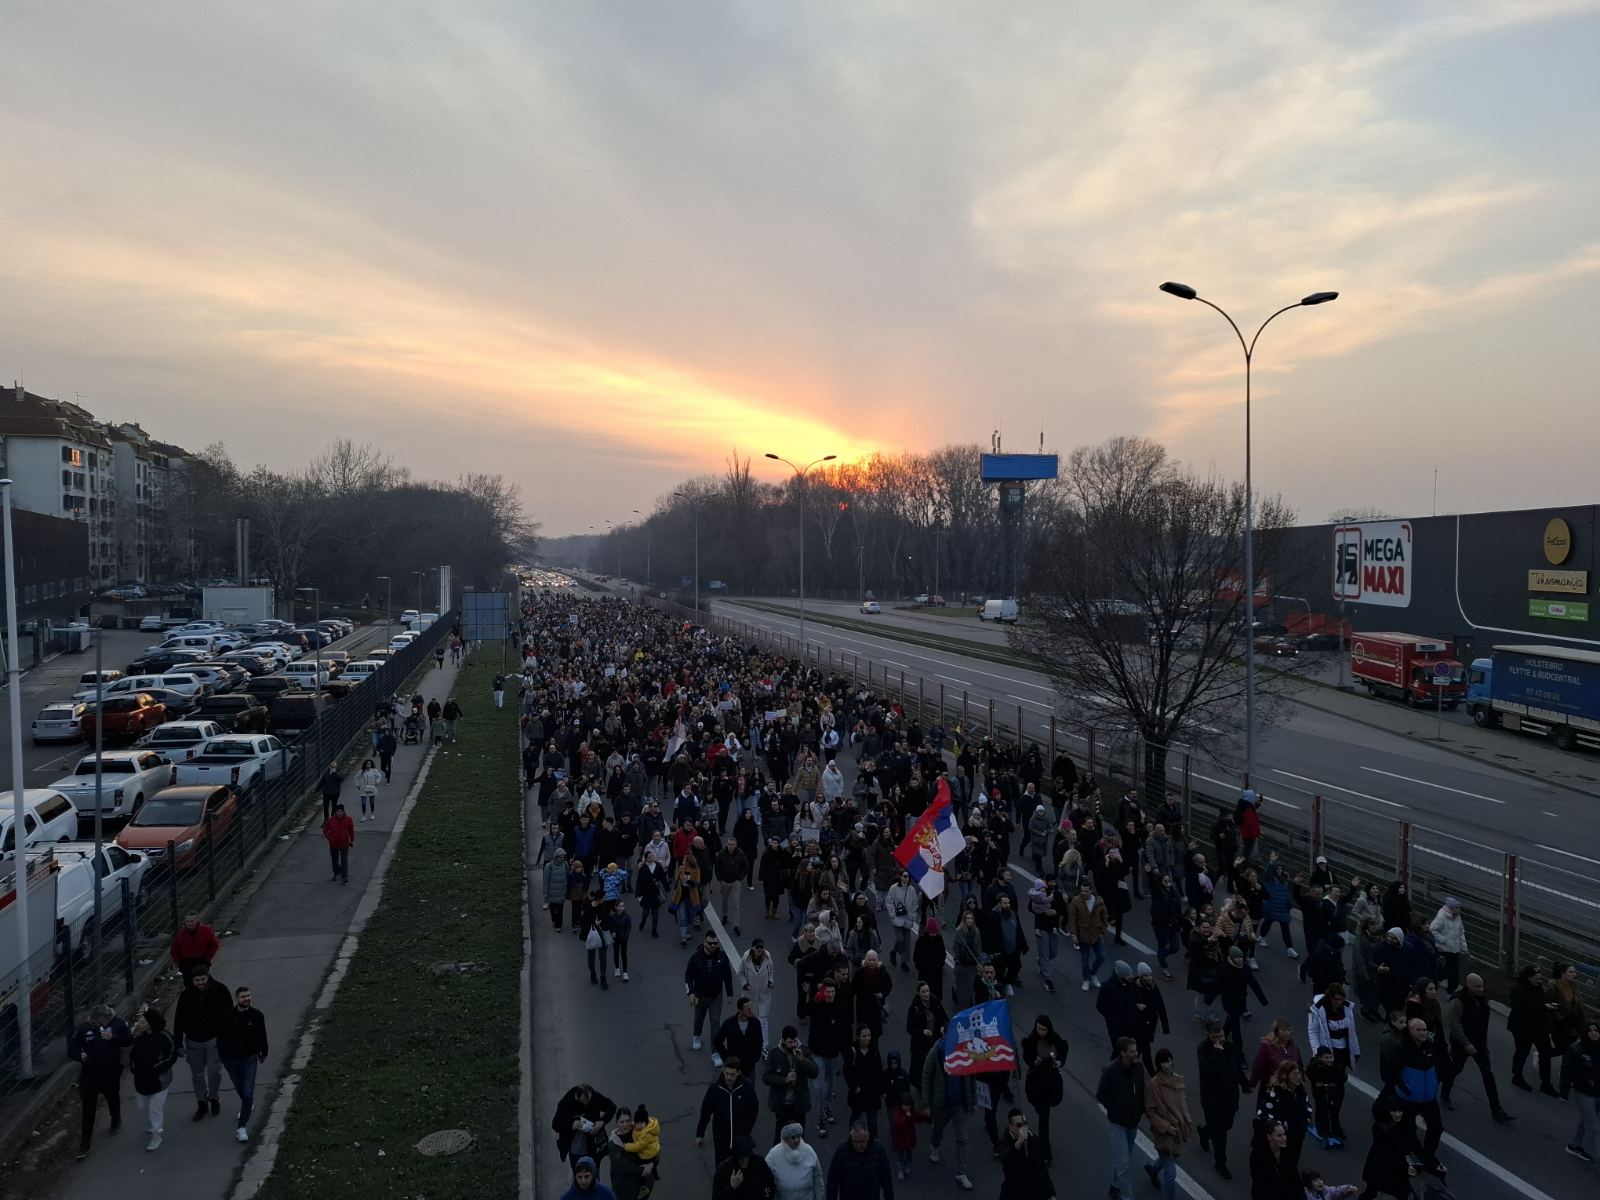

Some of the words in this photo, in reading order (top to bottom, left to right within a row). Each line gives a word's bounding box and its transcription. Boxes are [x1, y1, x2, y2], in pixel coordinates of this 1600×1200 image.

[1364, 538, 1404, 562] MEGA
[1364, 565, 1404, 595] MAXI
[1509, 665, 1531, 677] FLYTTE
[1525, 658, 1563, 671] HOLSTEBRO
